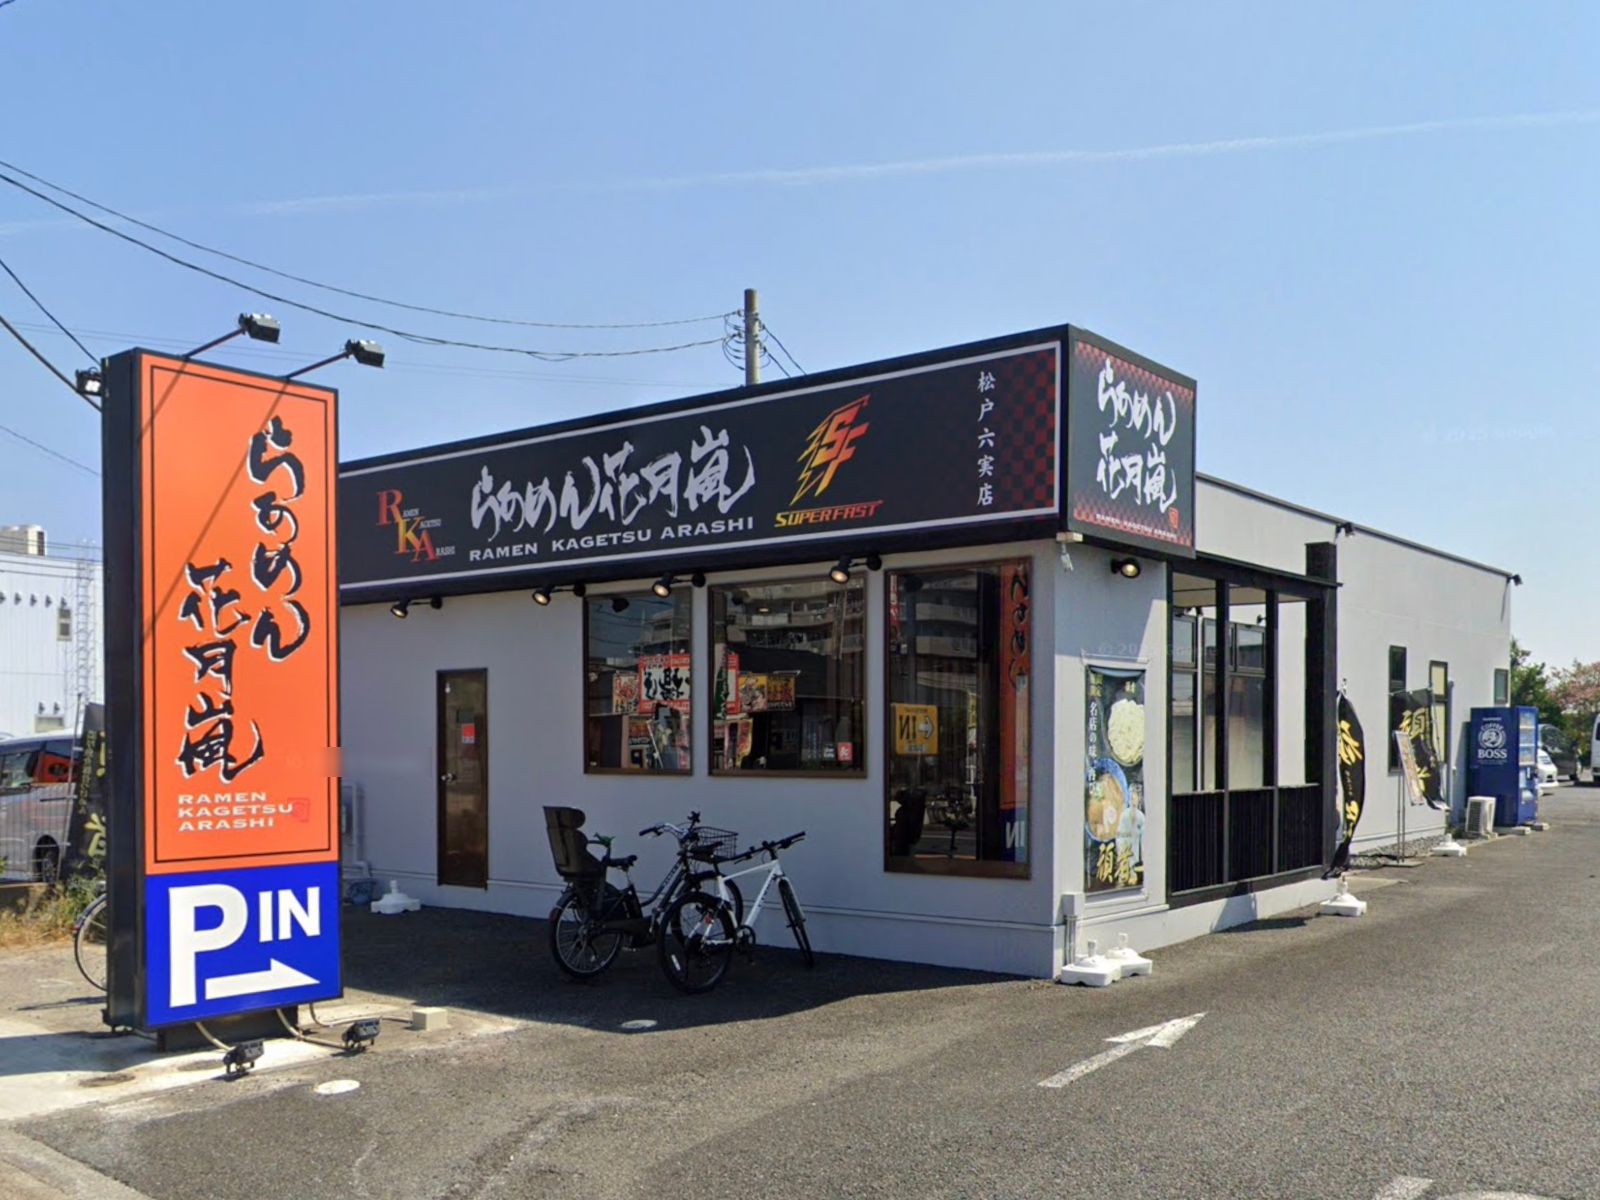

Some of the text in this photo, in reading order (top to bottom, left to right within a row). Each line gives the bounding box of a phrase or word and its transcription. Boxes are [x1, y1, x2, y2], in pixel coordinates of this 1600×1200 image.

[976, 371, 997, 507] 松戸六実店
[1096, 430, 1178, 514] 花月嵐
[774, 500, 884, 528] SUPERFAST
[469, 516, 754, 561] RAMEN KAGETSU ARASHI
[175, 558, 266, 785] 花月嵐
[1478, 749, 1508, 759] BOSS
[178, 791, 266, 804] RAMEN
[178, 803, 293, 818] KAGETSU
[178, 817, 274, 832] ARASHI
[168, 883, 321, 1008] P IN
